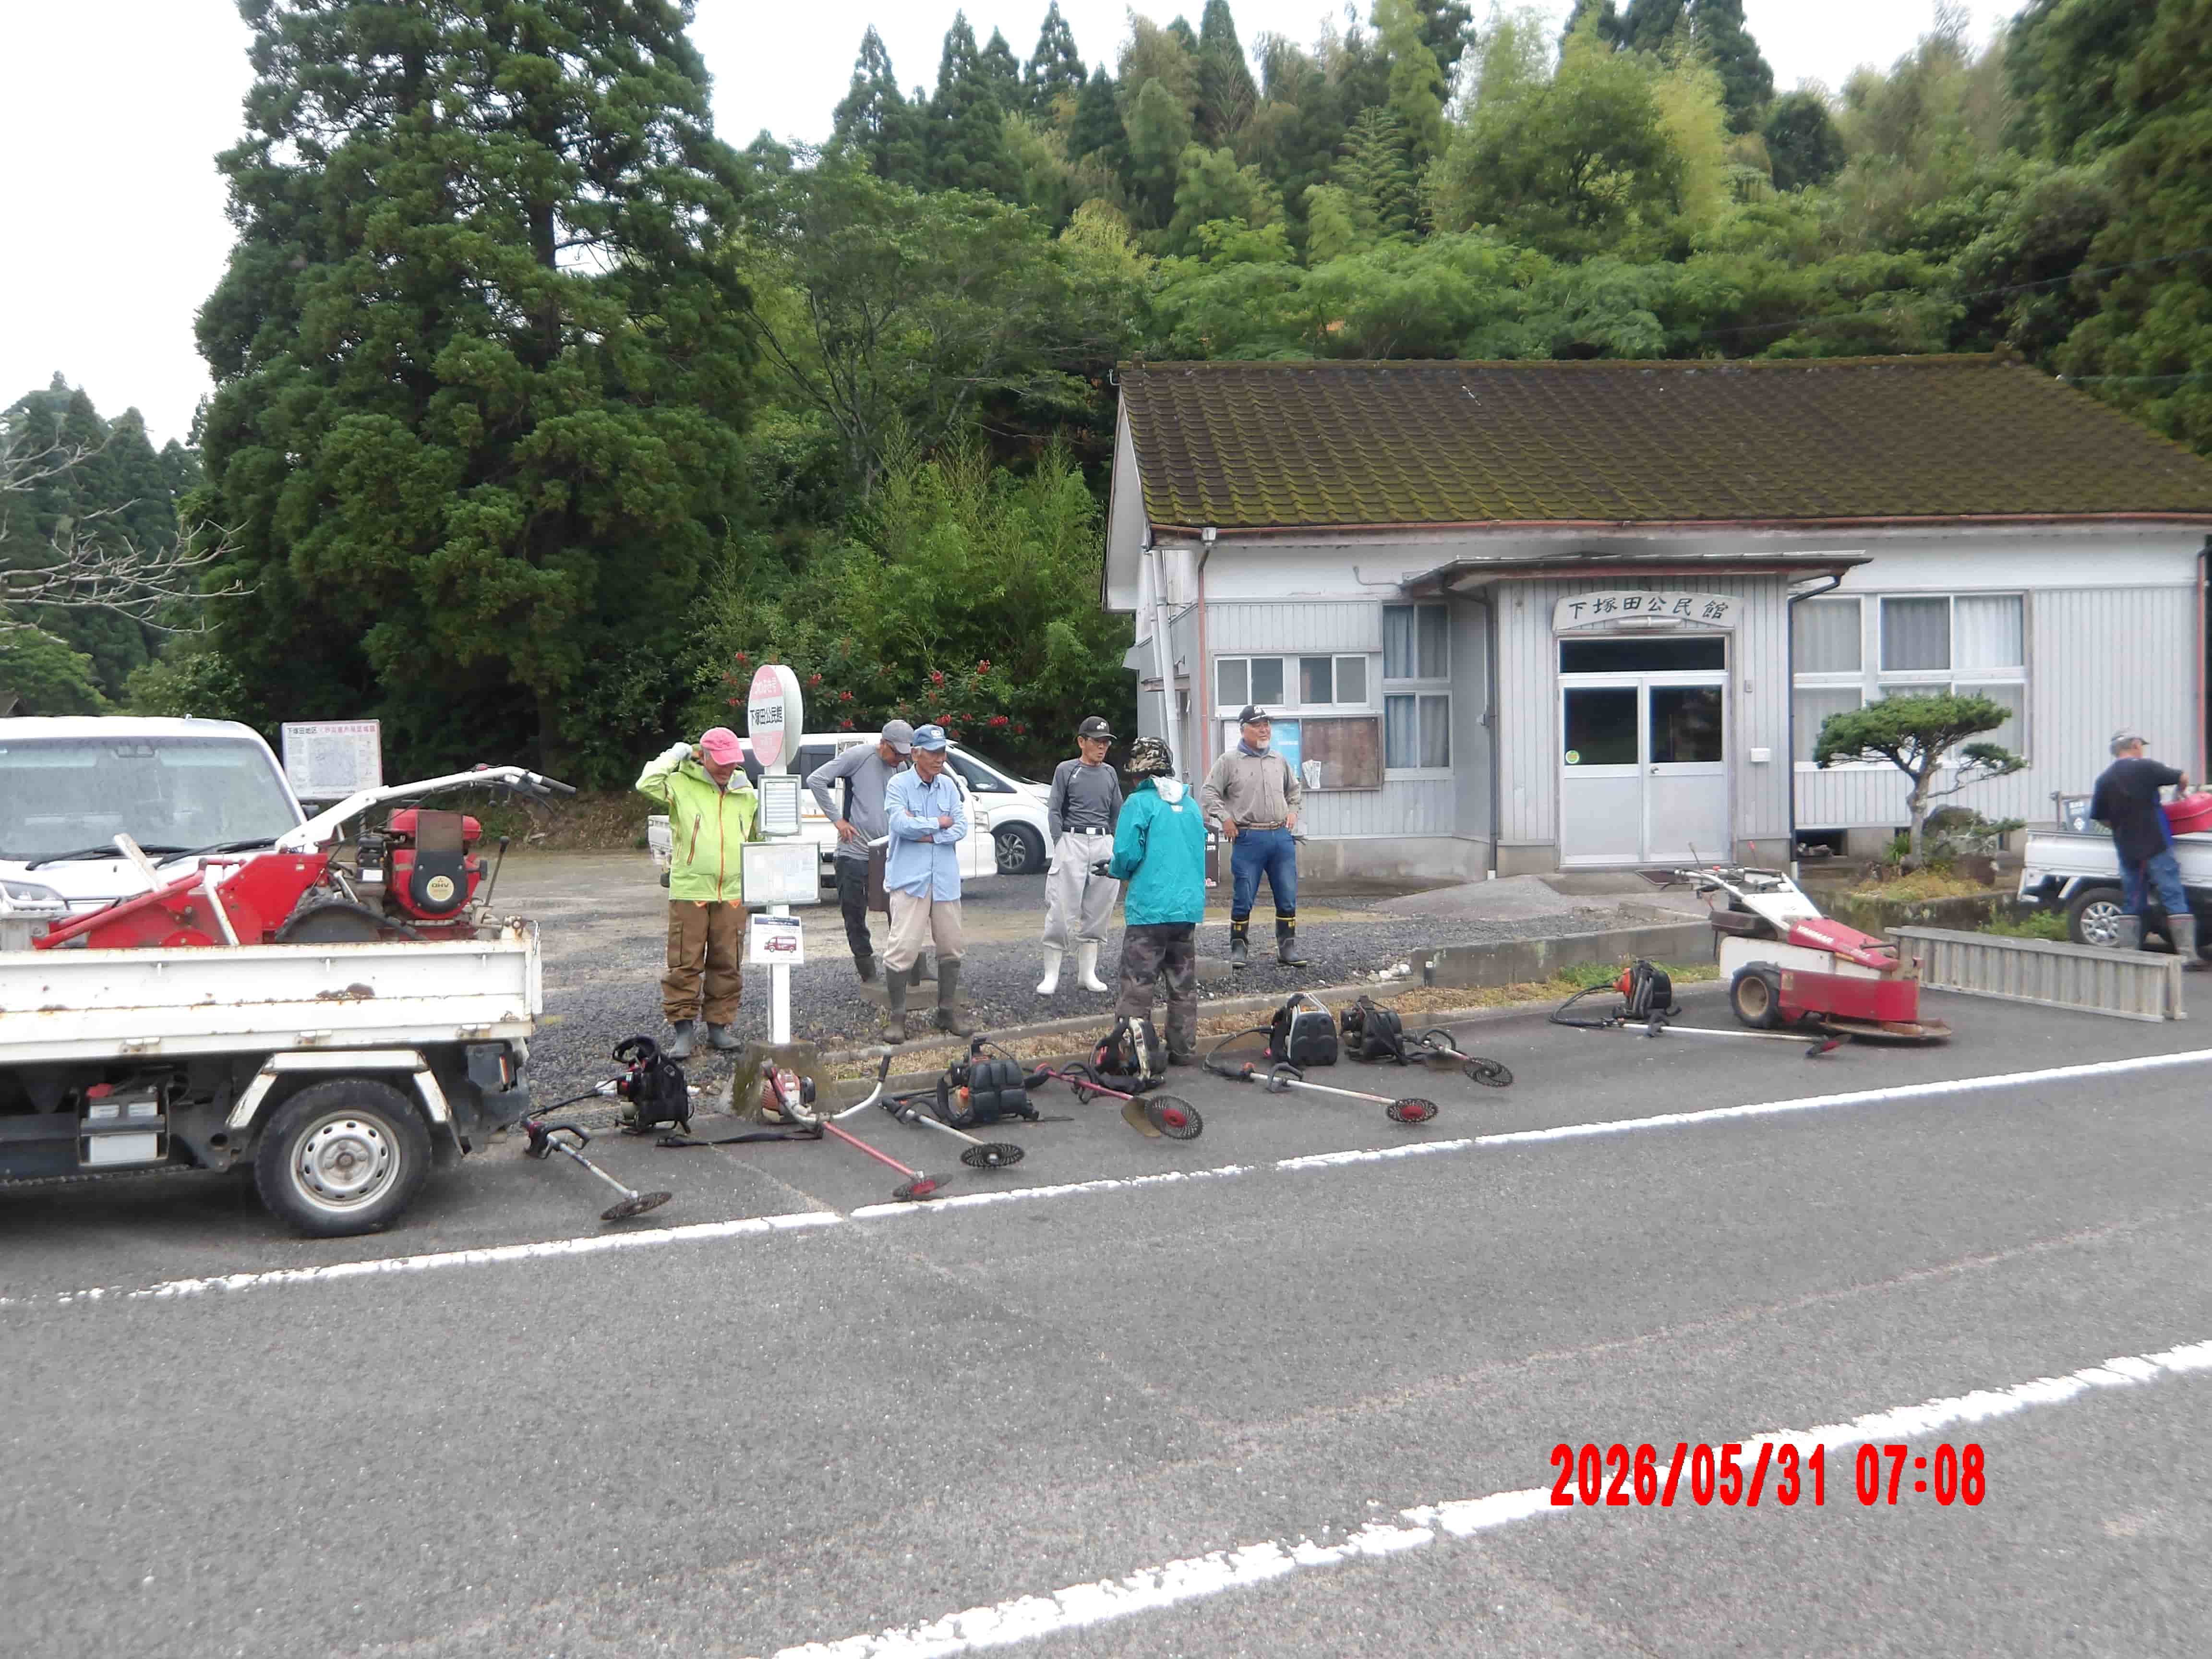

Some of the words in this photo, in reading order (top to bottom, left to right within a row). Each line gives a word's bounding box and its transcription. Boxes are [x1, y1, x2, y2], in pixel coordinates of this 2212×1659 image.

[1568, 596, 1729, 620] 下塚田公民館
[1797, 925, 1834, 945] YANMAR
